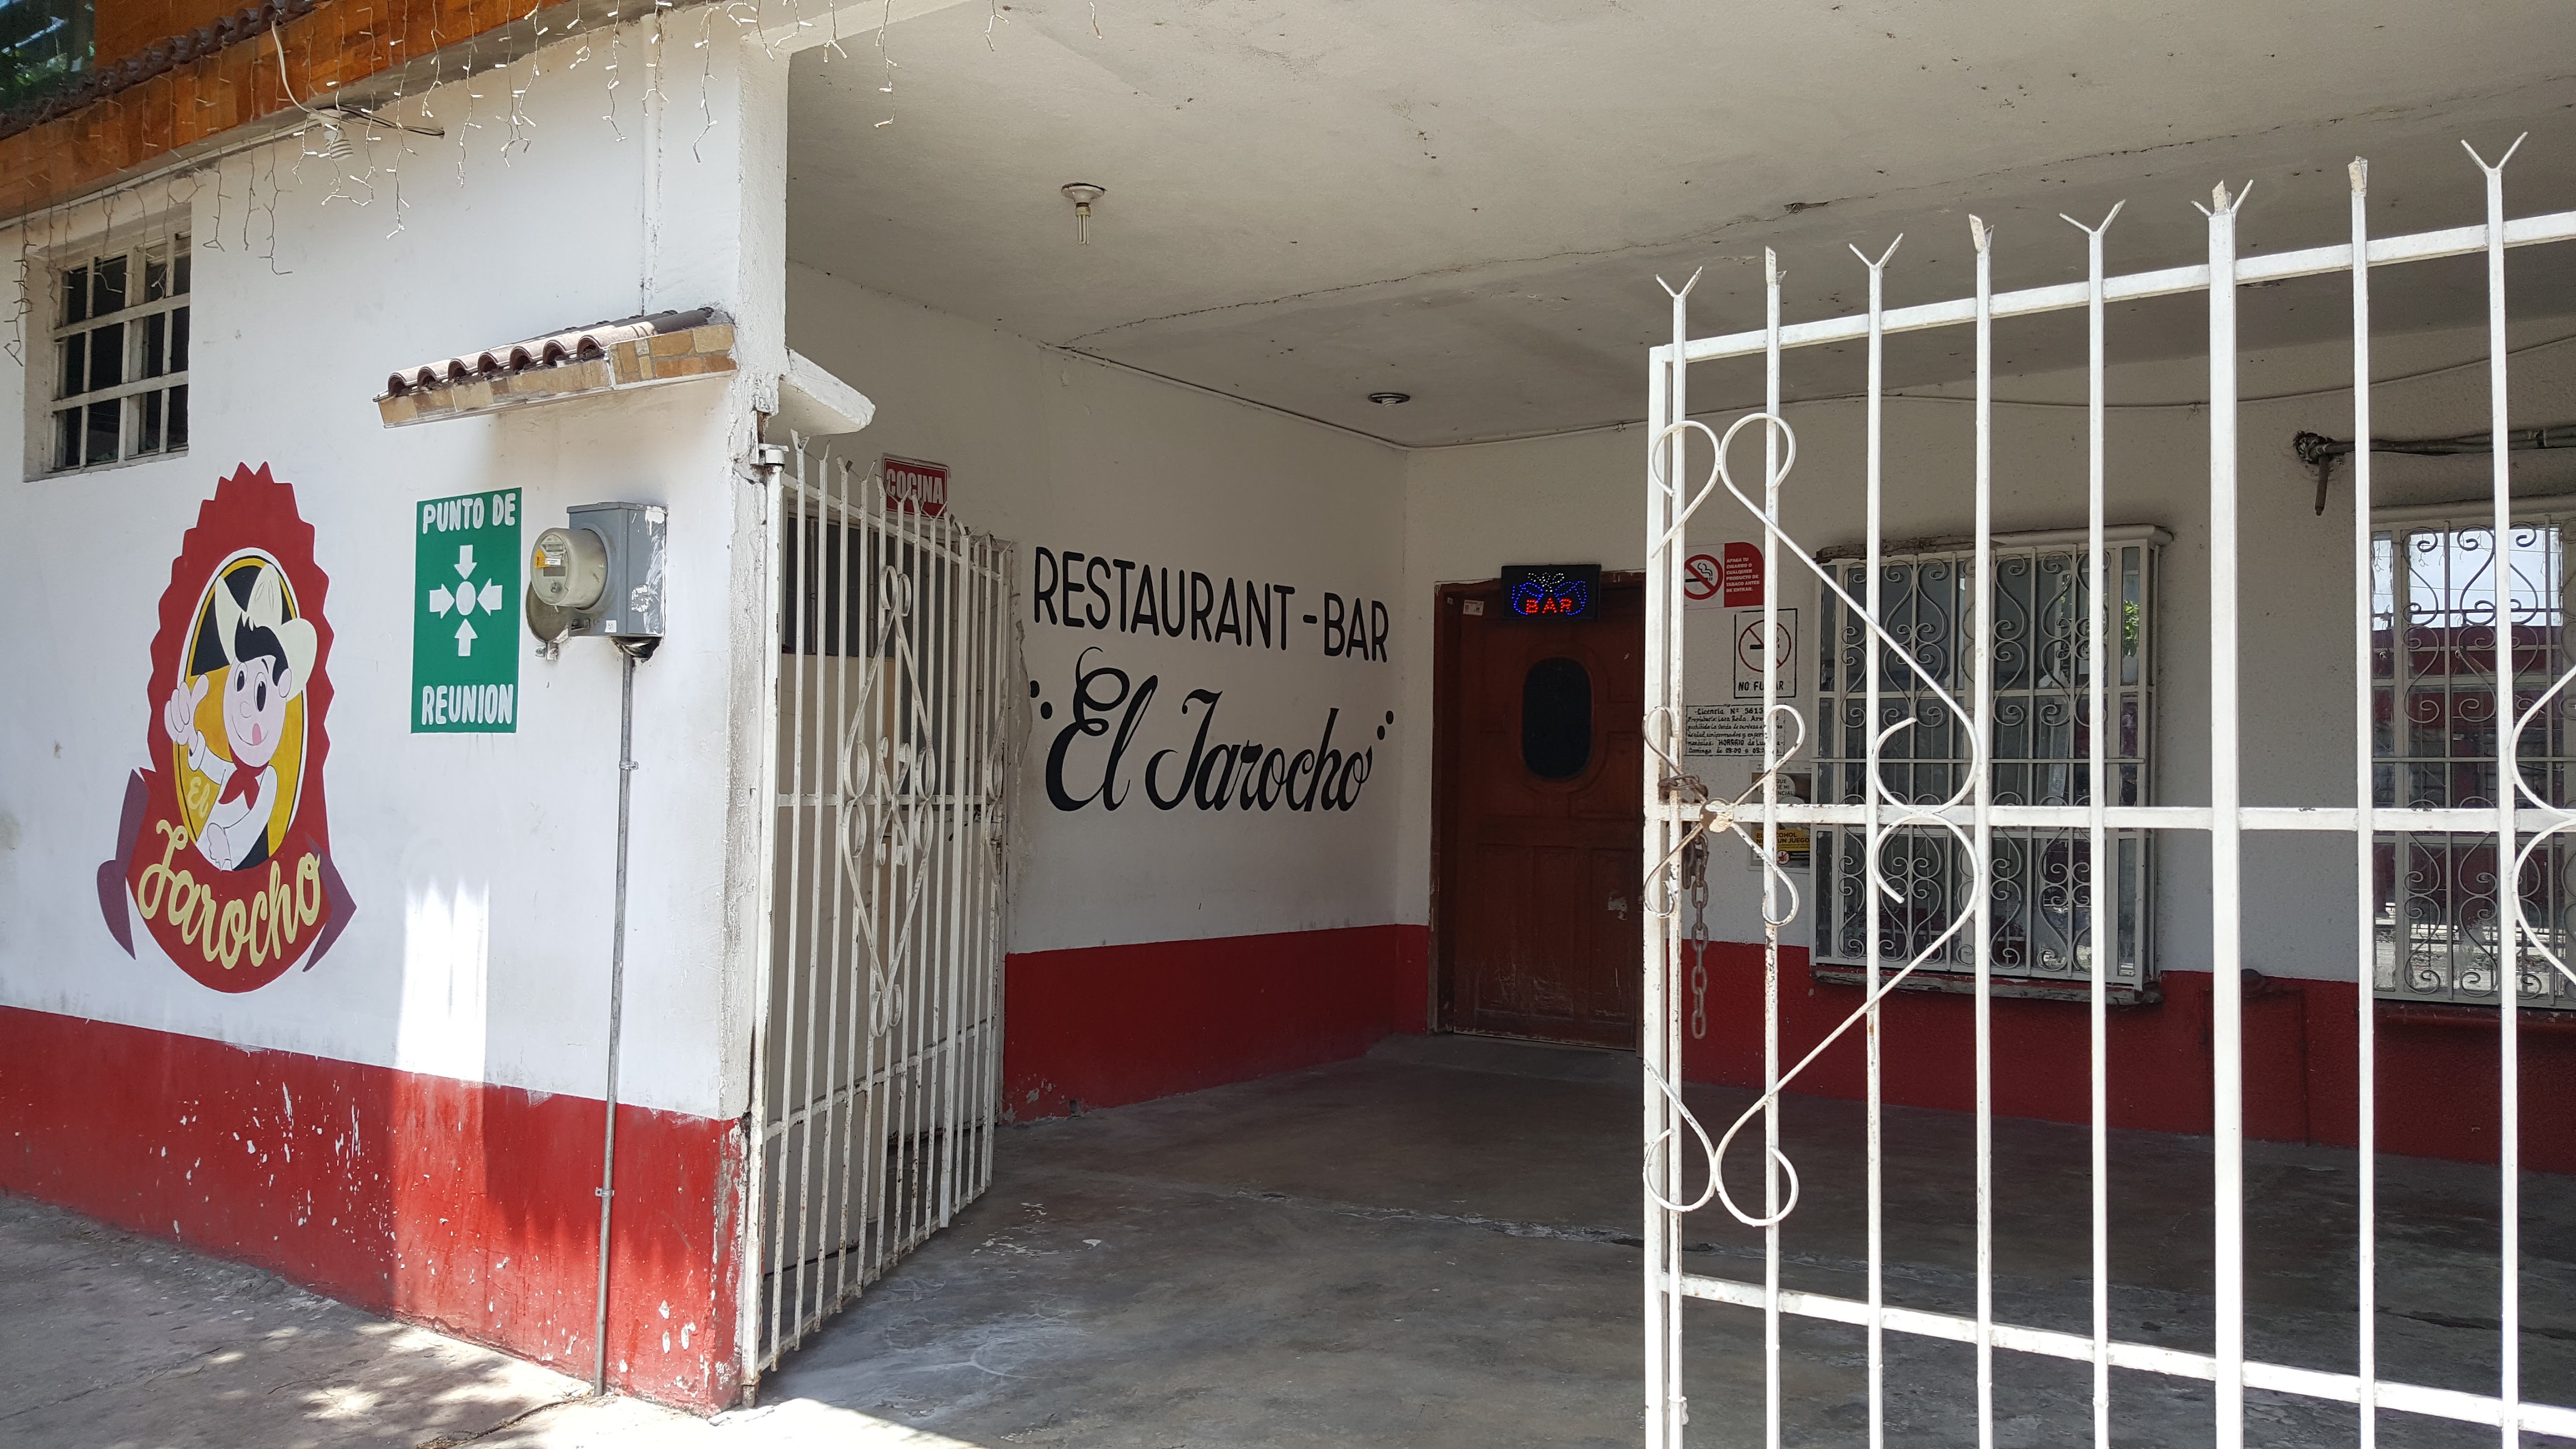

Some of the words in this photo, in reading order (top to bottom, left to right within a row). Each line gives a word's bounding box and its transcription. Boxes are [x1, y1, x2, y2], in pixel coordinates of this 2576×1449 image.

[887, 468, 943, 504] COCINA
[423, 497, 484, 534] PUNTO
[492, 493, 516, 526] DE
[1034, 546, 1295, 650] RESTAURANT
[1525, 597, 1567, 613] BAR
[421, 684, 514, 725] REUNION
[1738, 681, 1749, 691] NO
[1045, 647, 1158, 811] El
[1145, 689, 1373, 812] Jarocho
[188, 777, 210, 818] El
[138, 819, 320, 970] Jarocho
